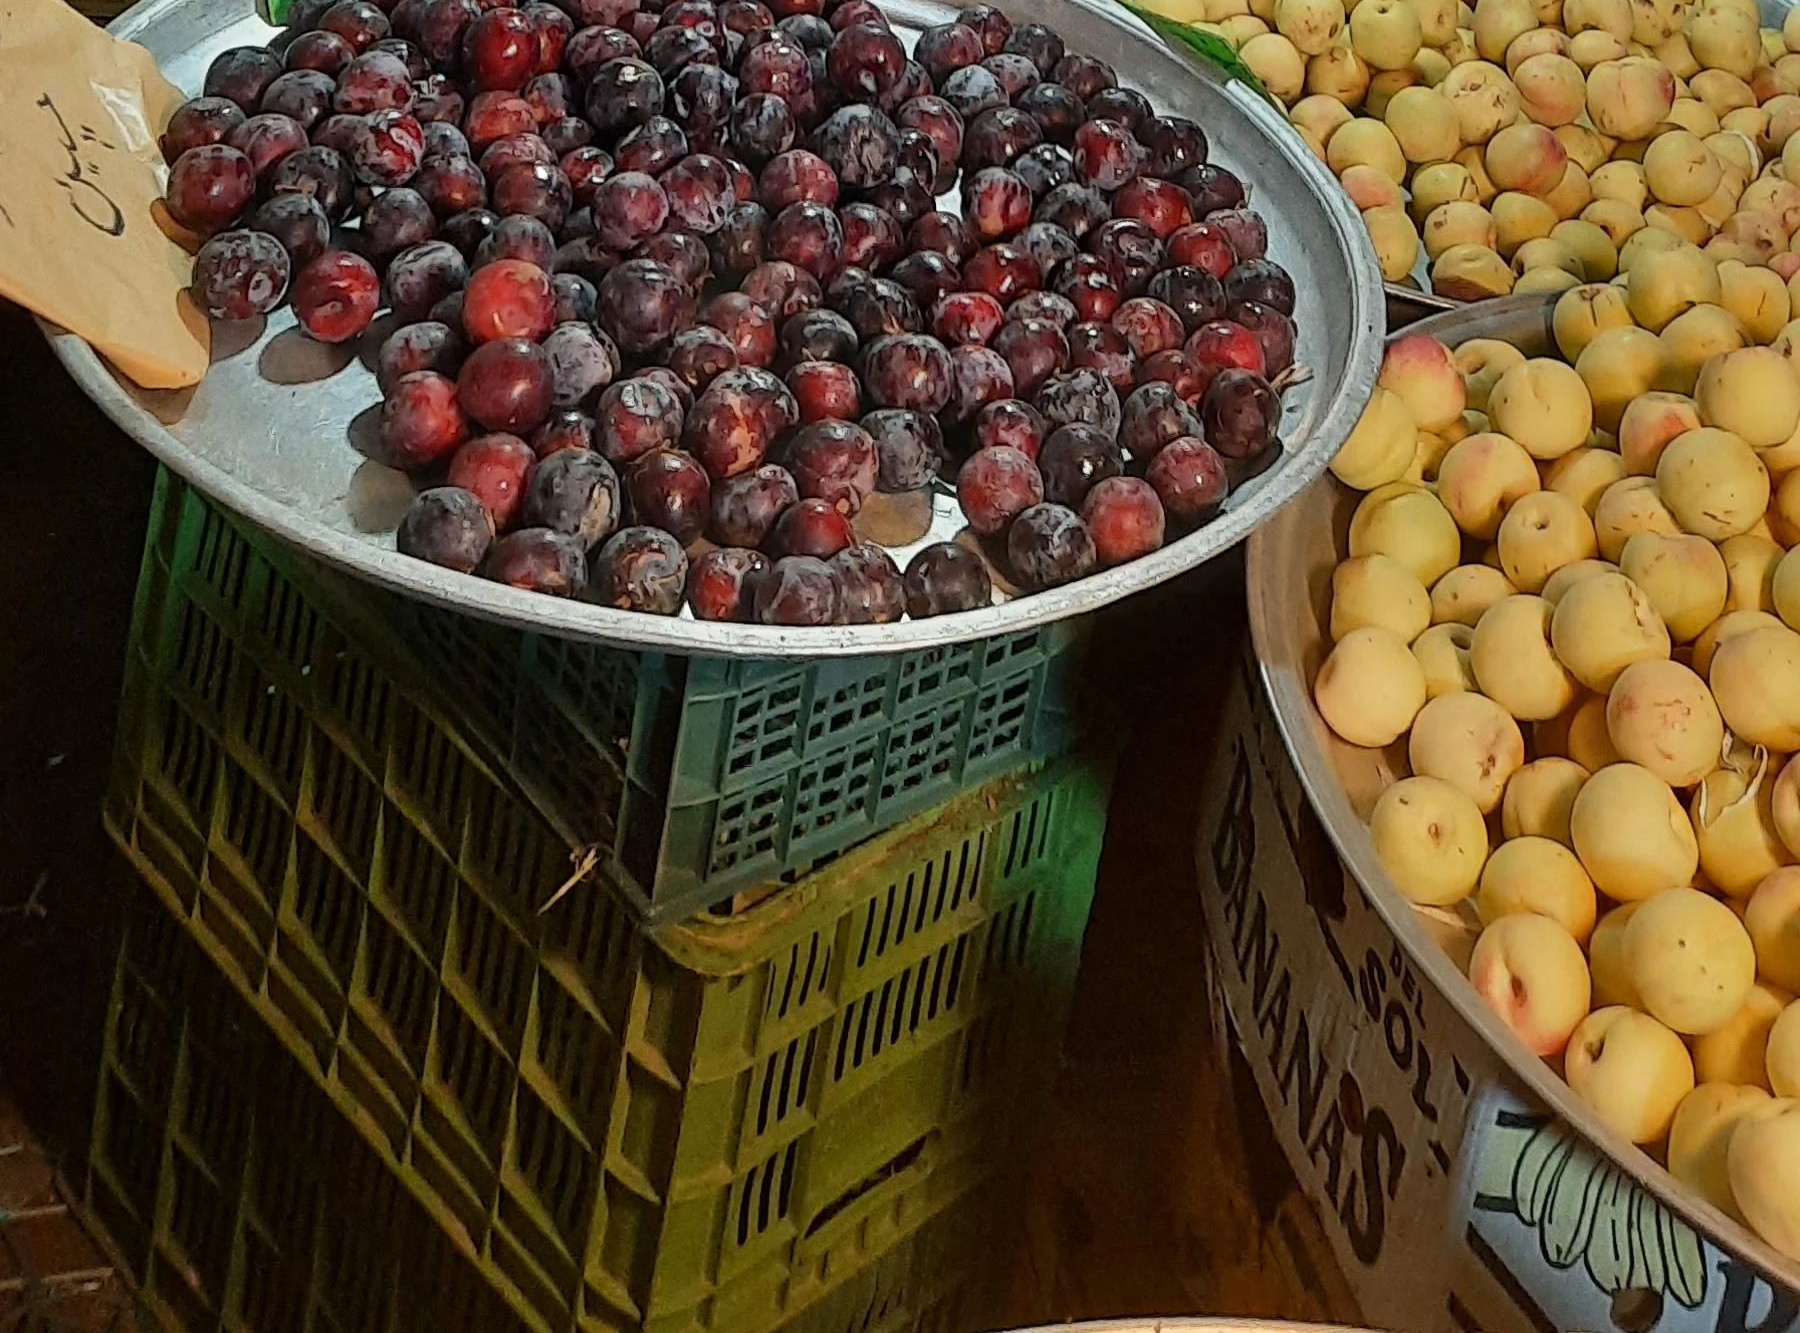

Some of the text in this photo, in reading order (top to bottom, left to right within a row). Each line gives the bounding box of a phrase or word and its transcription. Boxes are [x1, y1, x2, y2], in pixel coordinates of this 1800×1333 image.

[1211, 733, 1406, 1266] BANANAS
[1360, 946, 1438, 1124] SOL
[1391, 939, 1426, 1030] DEL
